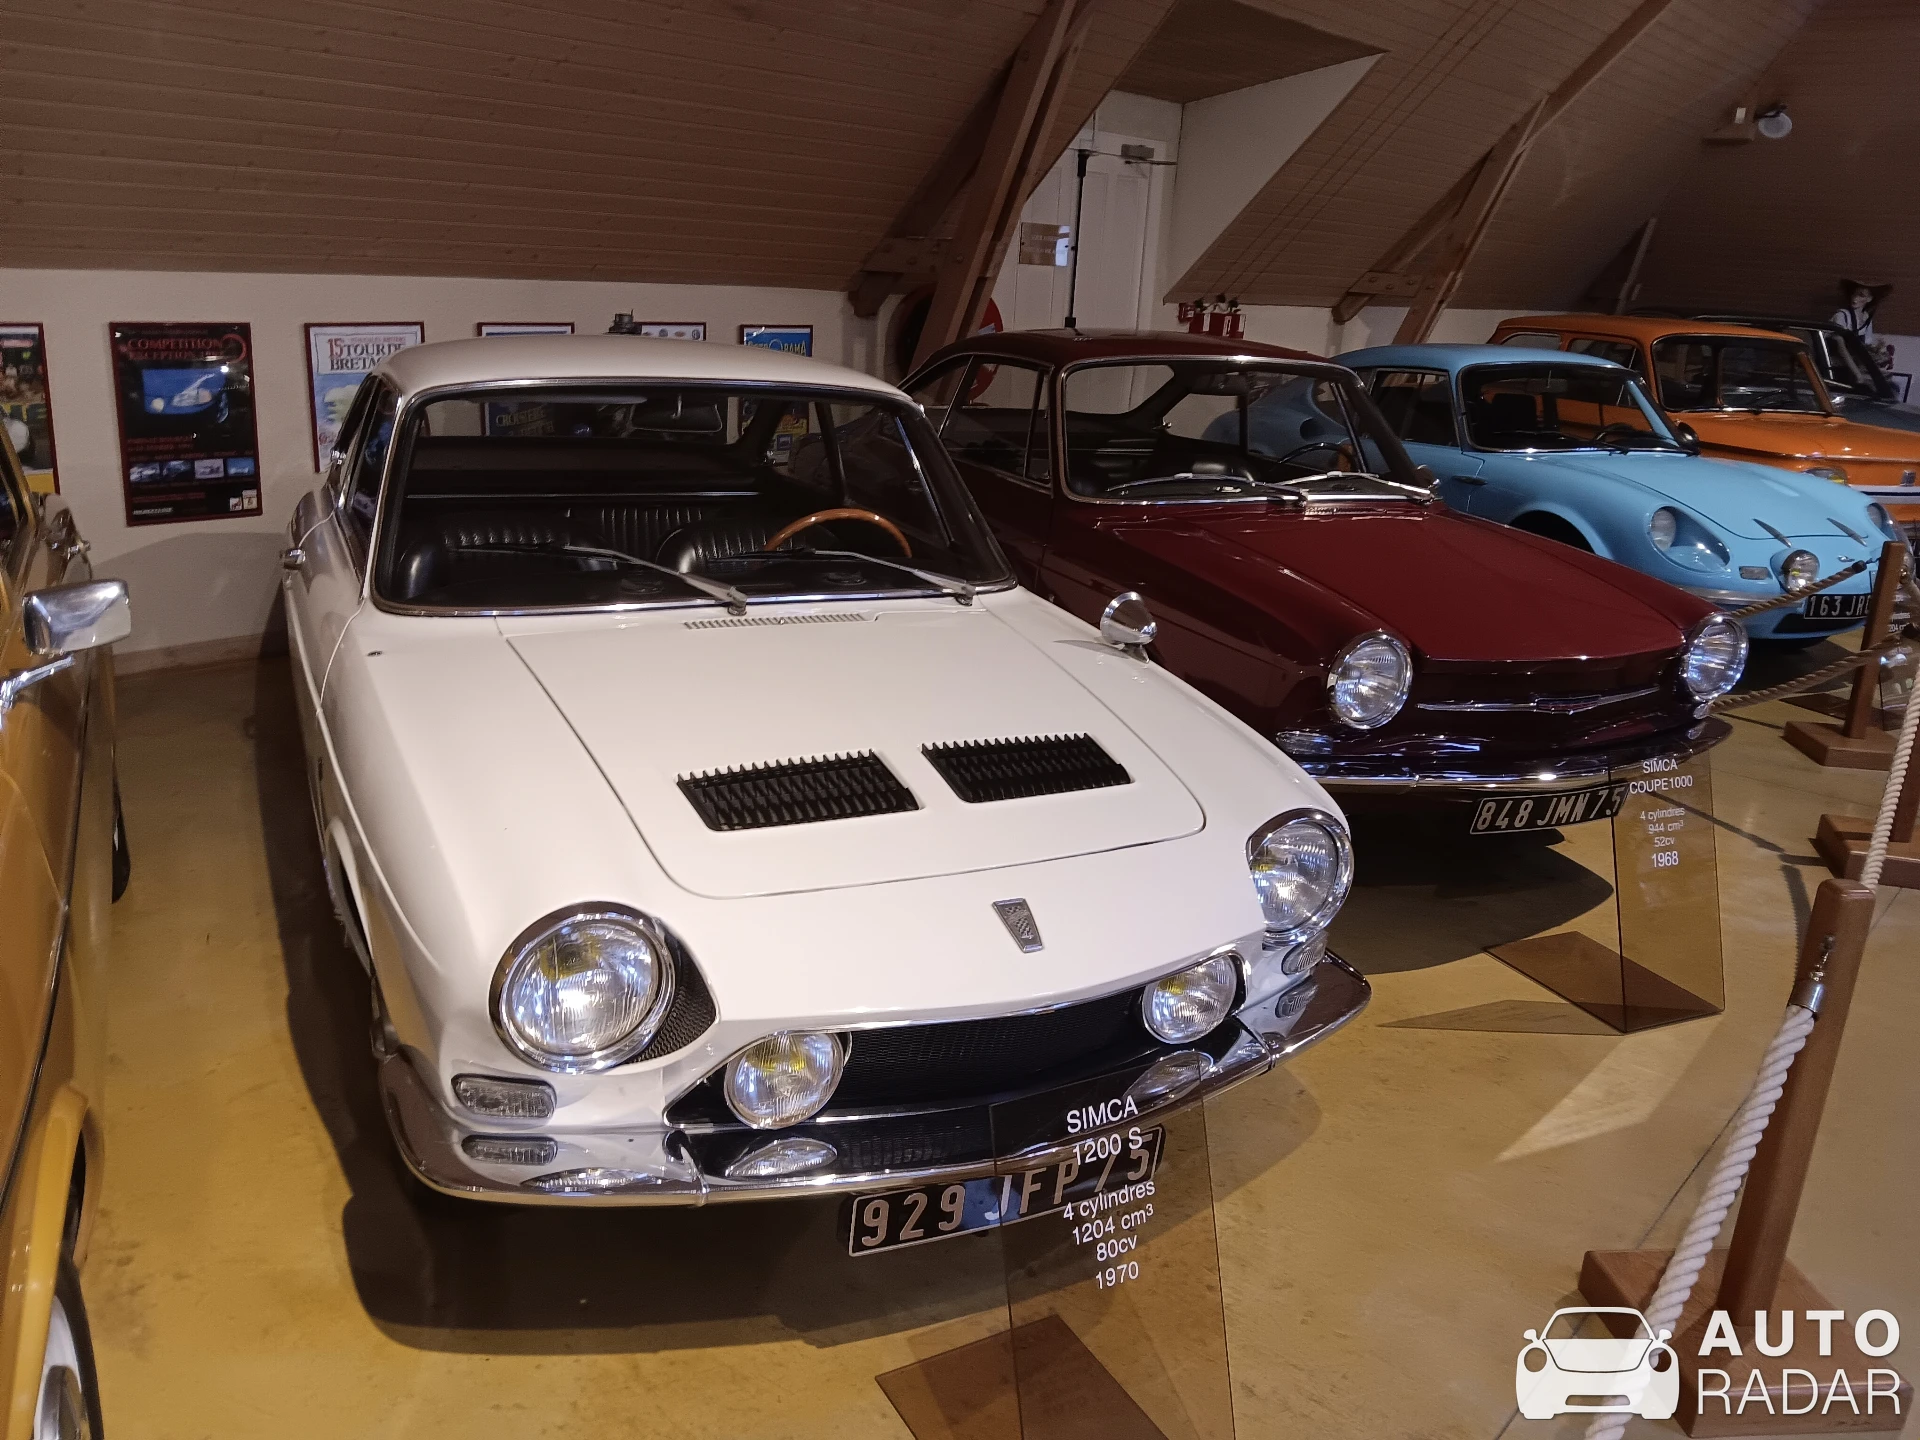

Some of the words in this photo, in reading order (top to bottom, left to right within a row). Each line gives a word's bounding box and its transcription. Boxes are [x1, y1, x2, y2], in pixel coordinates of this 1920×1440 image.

[344, 343, 386, 356] TOUR
[330, 355, 381, 371] BRETA
[1809, 595, 1842, 617] 163
[1642, 758, 1679, 774] SIMCA
[1477, 799, 1534, 831] 848
[1537, 793, 1590, 826] JMN
[1640, 810, 1646, 821] 4
[1648, 806, 1685, 822] cylindres
[1648, 823, 1665, 835] 944
[1654, 836, 1675, 848] 52cv
[1652, 850, 1679, 868] 1968
[1067, 1095, 1139, 1133] SIMCA
[1072, 1133, 1122, 1166] 1200
[1128, 1126, 1143, 1150] S
[861, 1184, 966, 1247] 929
[984, 1157, 1080, 1220] JFP
[1063, 1202, 1075, 1221] 4
[1080, 1179, 1156, 1218] cylindres
[1072, 1214, 1114, 1246] 1204
[1096, 1235, 1138, 1262] 80cv
[1095, 1261, 1140, 1290] 1970
